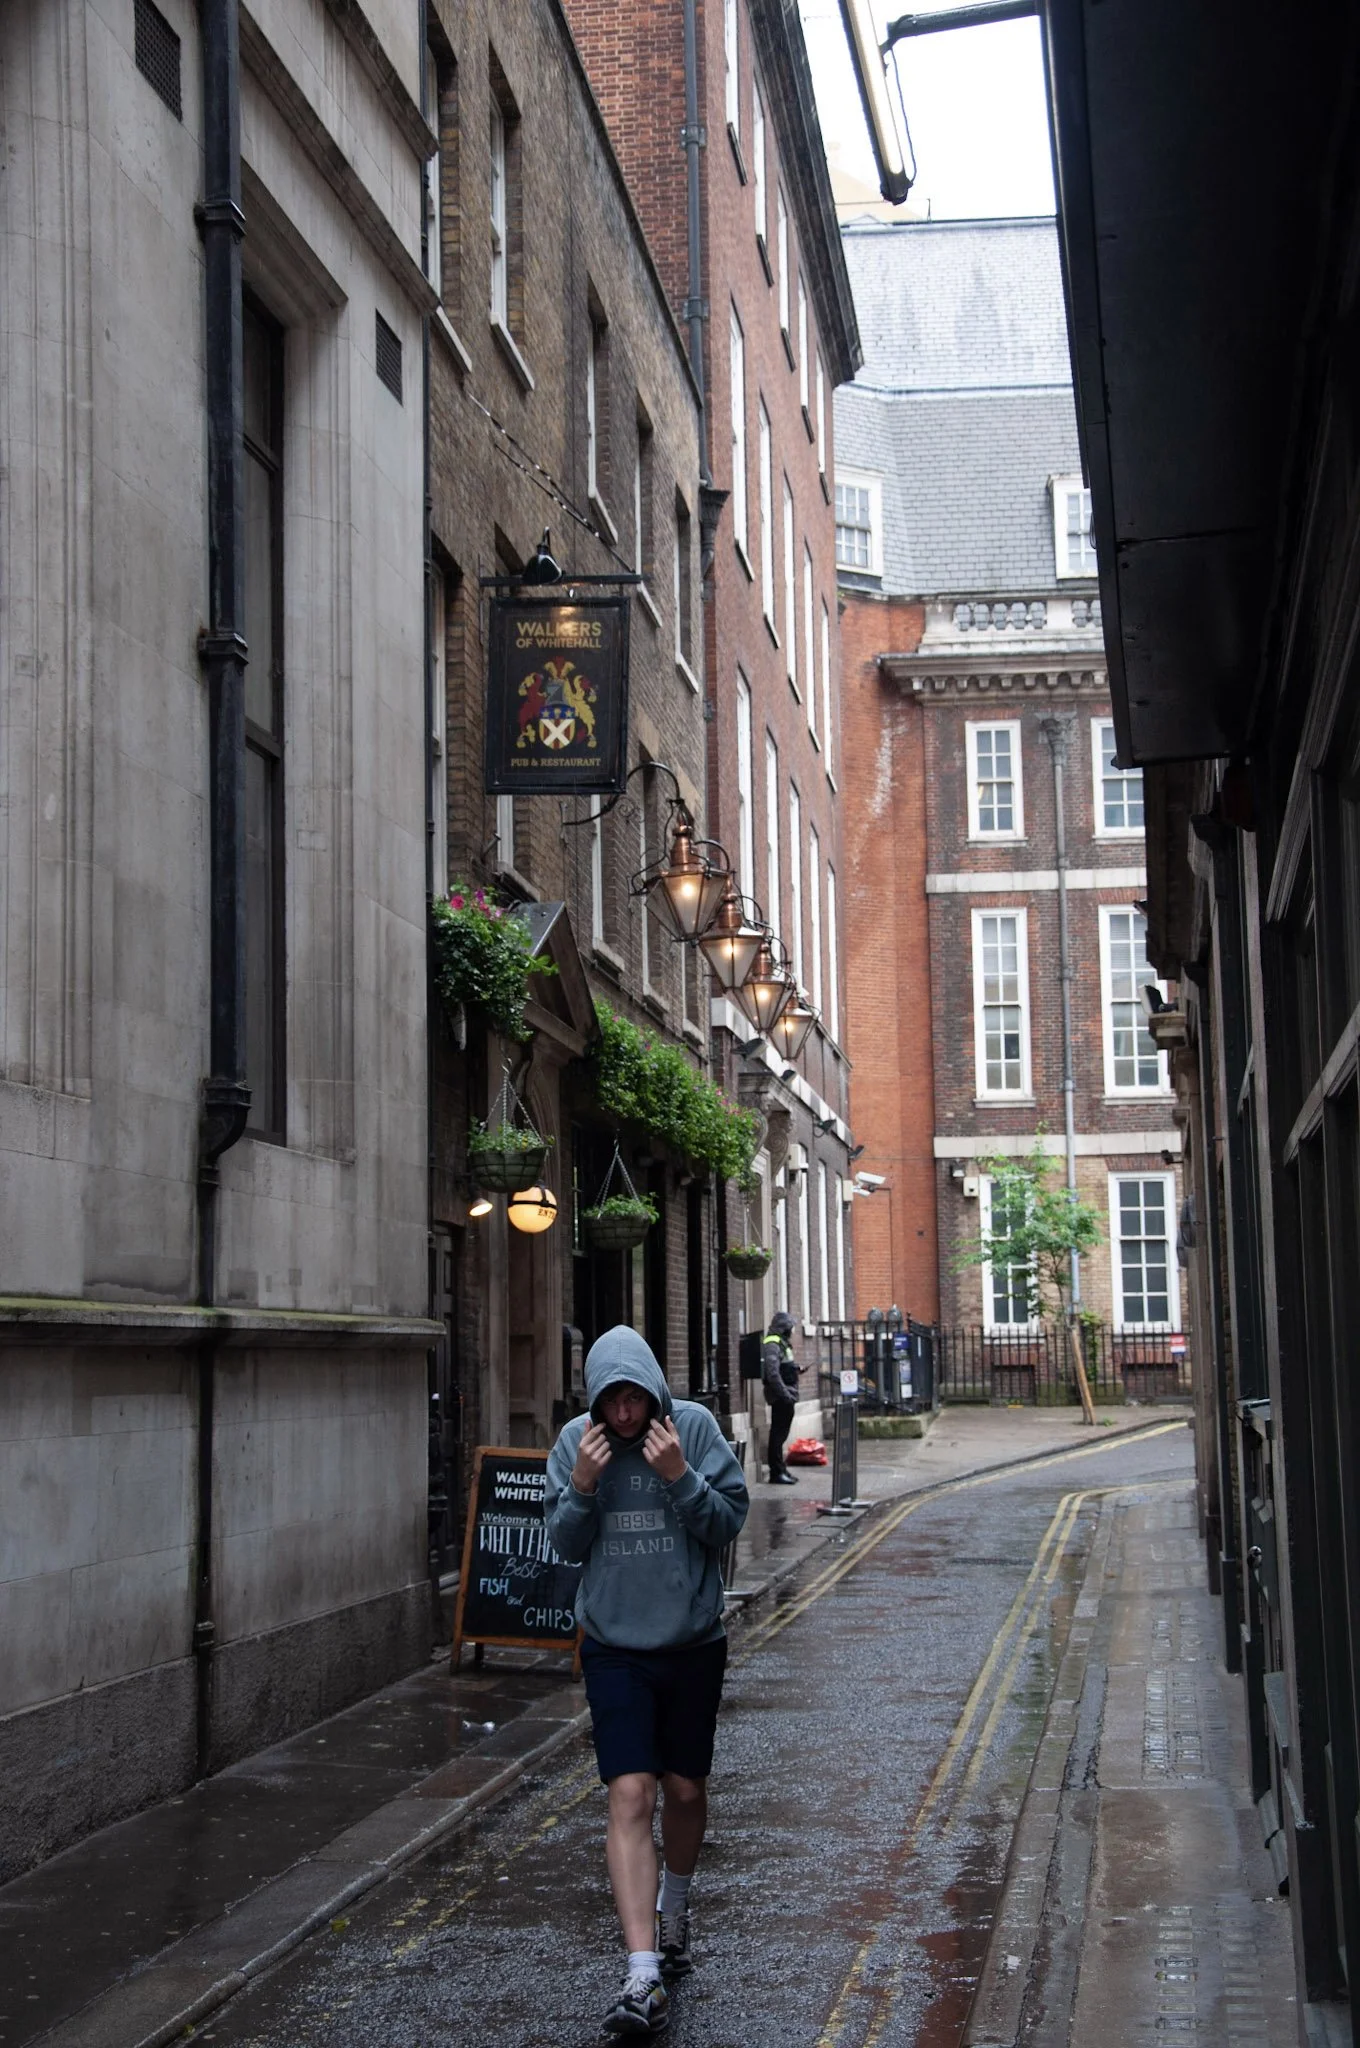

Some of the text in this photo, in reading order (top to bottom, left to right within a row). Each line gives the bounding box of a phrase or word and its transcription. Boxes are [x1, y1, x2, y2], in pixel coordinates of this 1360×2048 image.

[516, 622, 602, 637] WALKERS
[516, 638, 602, 649] OF WHITEHALL
[511, 758, 601, 767] PUB & RESTAURANT
[482, 1512, 528, 1526] Welcome
[530, 1516, 541, 1526] to
[602, 1537, 675, 1557] ISLAND
[480, 1578, 509, 1596] FISH
[523, 1606, 575, 1632] CHIPS
